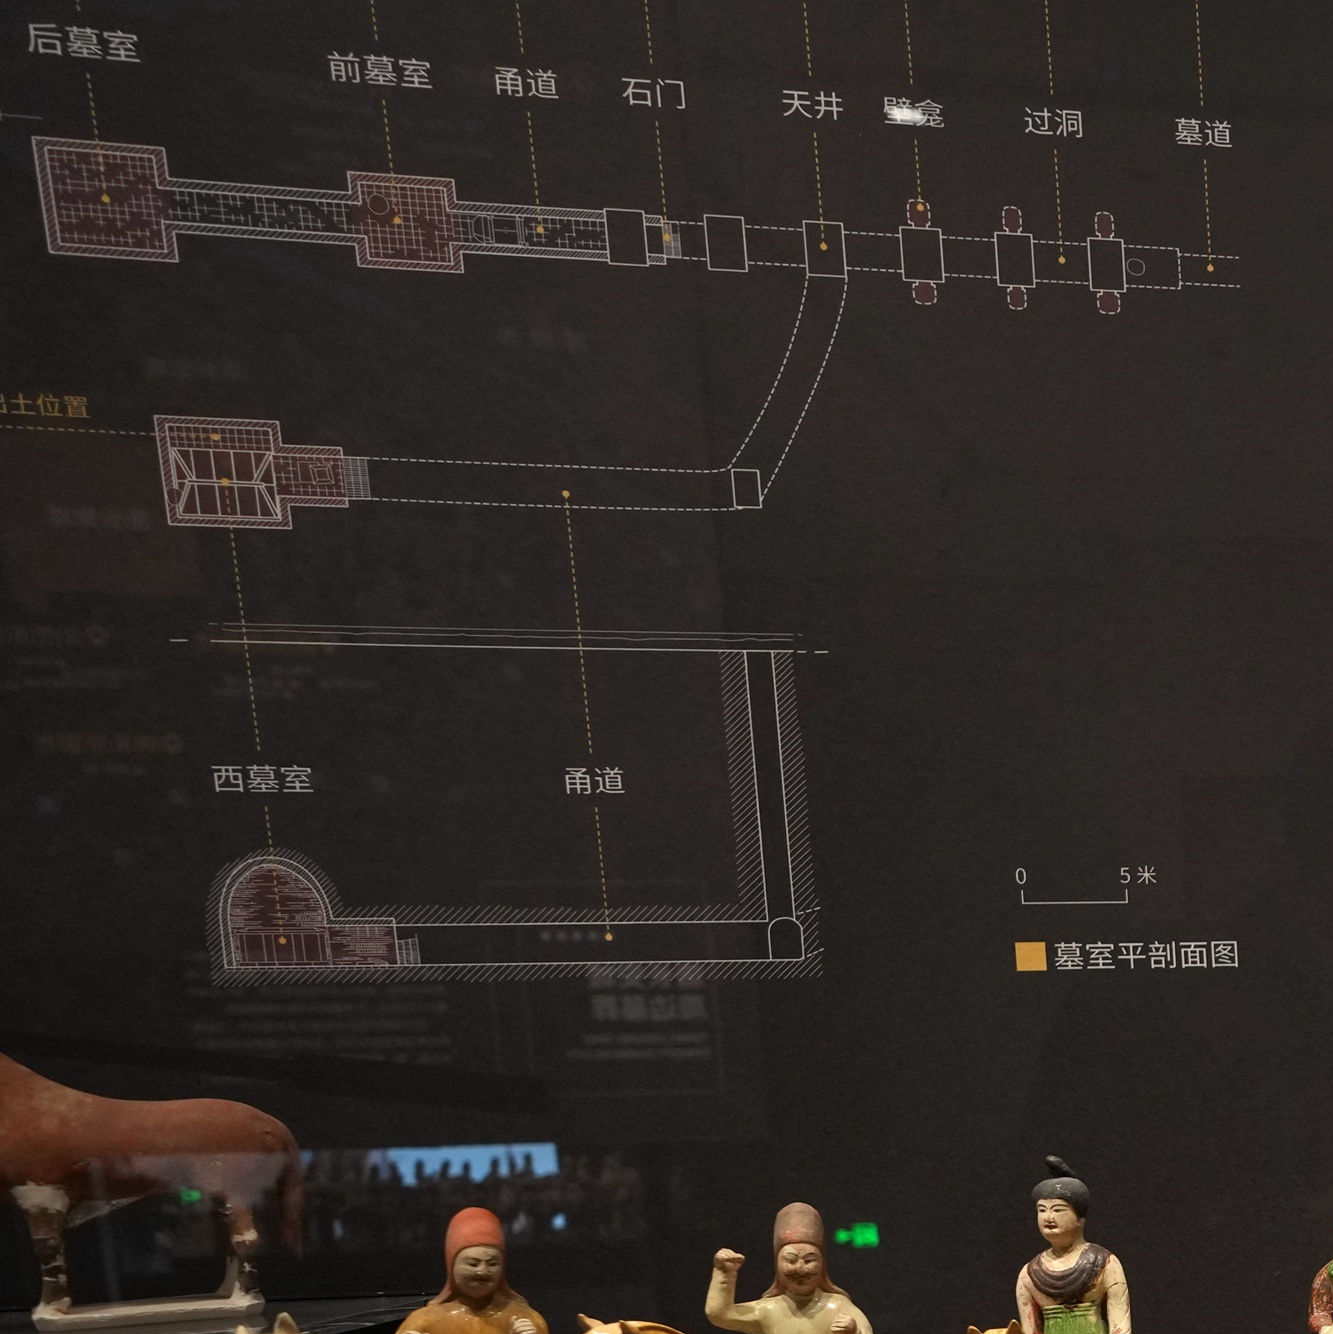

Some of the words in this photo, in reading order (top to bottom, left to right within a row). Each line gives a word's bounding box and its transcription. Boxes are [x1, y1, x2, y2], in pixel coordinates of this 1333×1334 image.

[27, 22, 141, 62] 后墓室
[326, 50, 433, 90] 前墓室
[494, 66, 559, 99] 甬道
[621, 77, 687, 109] 石门
[782, 89, 844, 121] 天井
[883, 96, 945, 129] 壁龛
[1024, 107, 1083, 138] 过洞
[1174, 118, 1233, 149] 墓道
[211, 765, 314, 794] 西墓室
[564, 766, 625, 796] 甬道
[1015, 868, 1027, 885] 0
[1053, 940, 1239, 970] 墓室平剖面图
